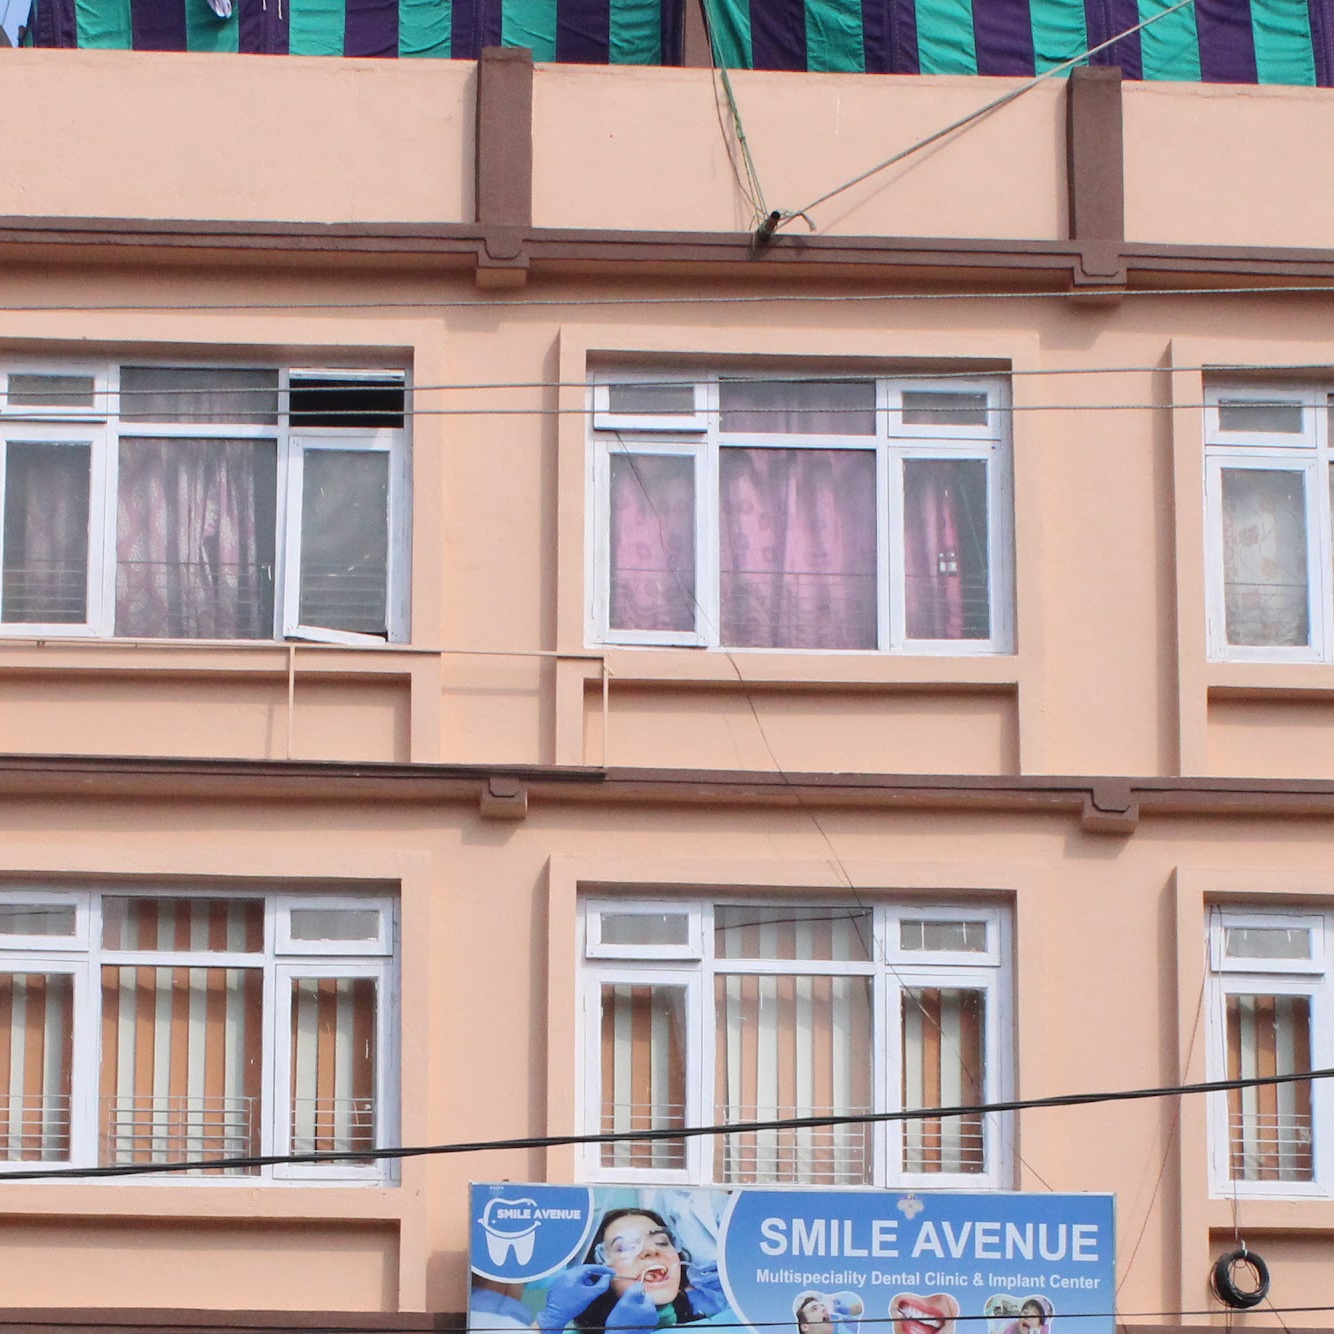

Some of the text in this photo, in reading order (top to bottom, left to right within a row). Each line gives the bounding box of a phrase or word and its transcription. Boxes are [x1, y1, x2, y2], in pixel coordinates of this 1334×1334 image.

[497, 1209, 581, 1220] SMILE AVENUE
[759, 1217, 1099, 1262] SMILE AVENUE
[756, 1269, 1101, 1290] Multispeciality Dental Clinic & Implant Center
